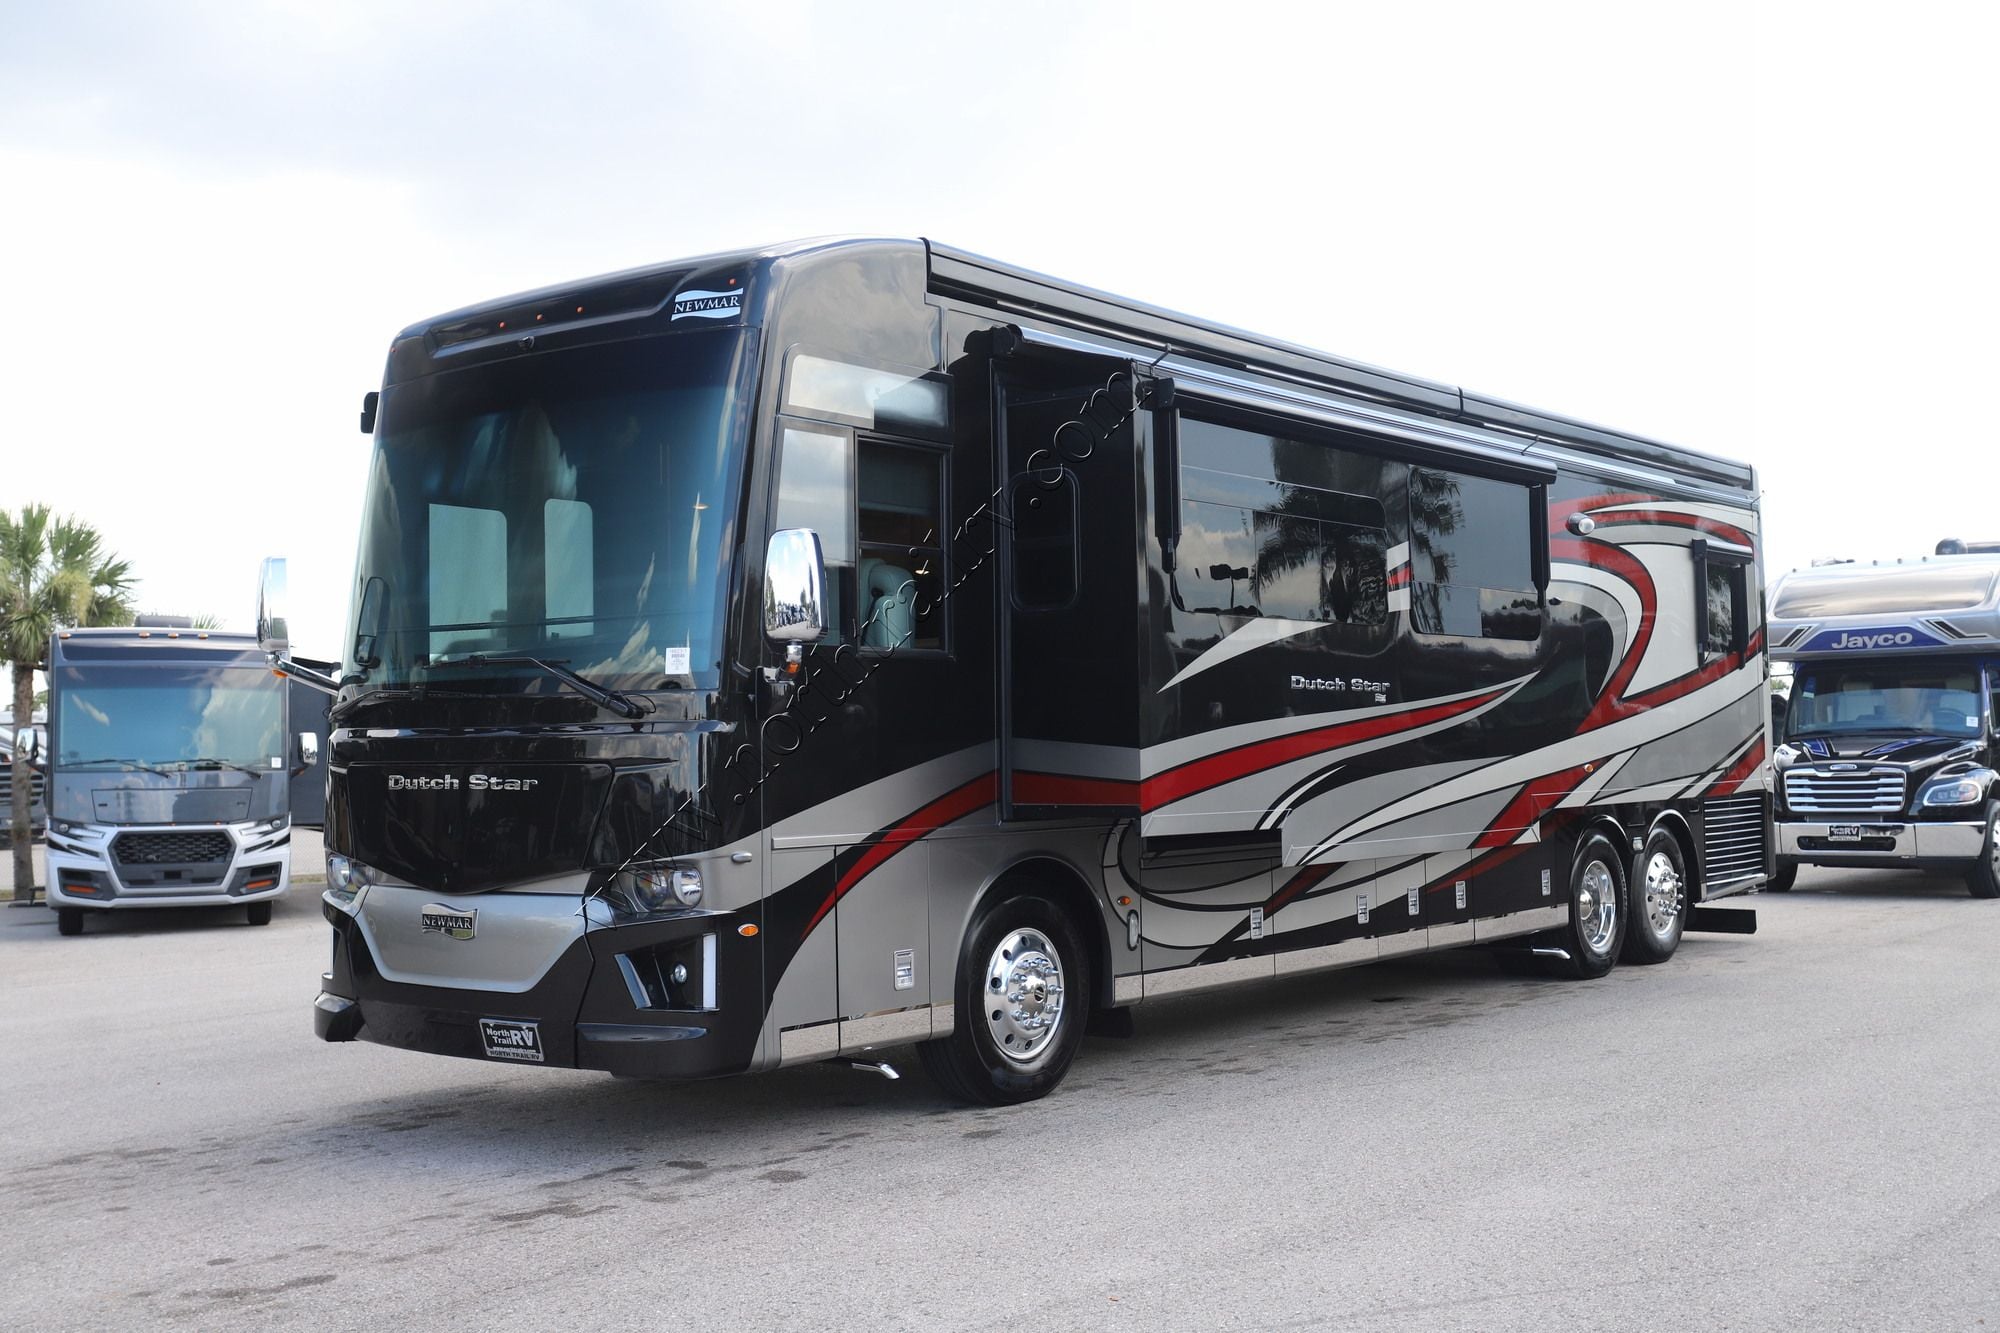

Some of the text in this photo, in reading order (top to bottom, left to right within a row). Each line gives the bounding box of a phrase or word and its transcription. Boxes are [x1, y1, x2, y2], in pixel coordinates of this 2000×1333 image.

[674, 296, 740, 314] NEWMAR
[1831, 632, 1913, 649] Jayco
[1290, 675, 1391, 692] Dutch Star
[388, 774, 539, 791] Dutch Star
[1844, 827, 1858, 835] RV
[423, 914, 472, 929] NEWMAR
[486, 1027, 510, 1037] North
[492, 1036, 512, 1045] Trail
[510, 1029, 533, 1046] RV
